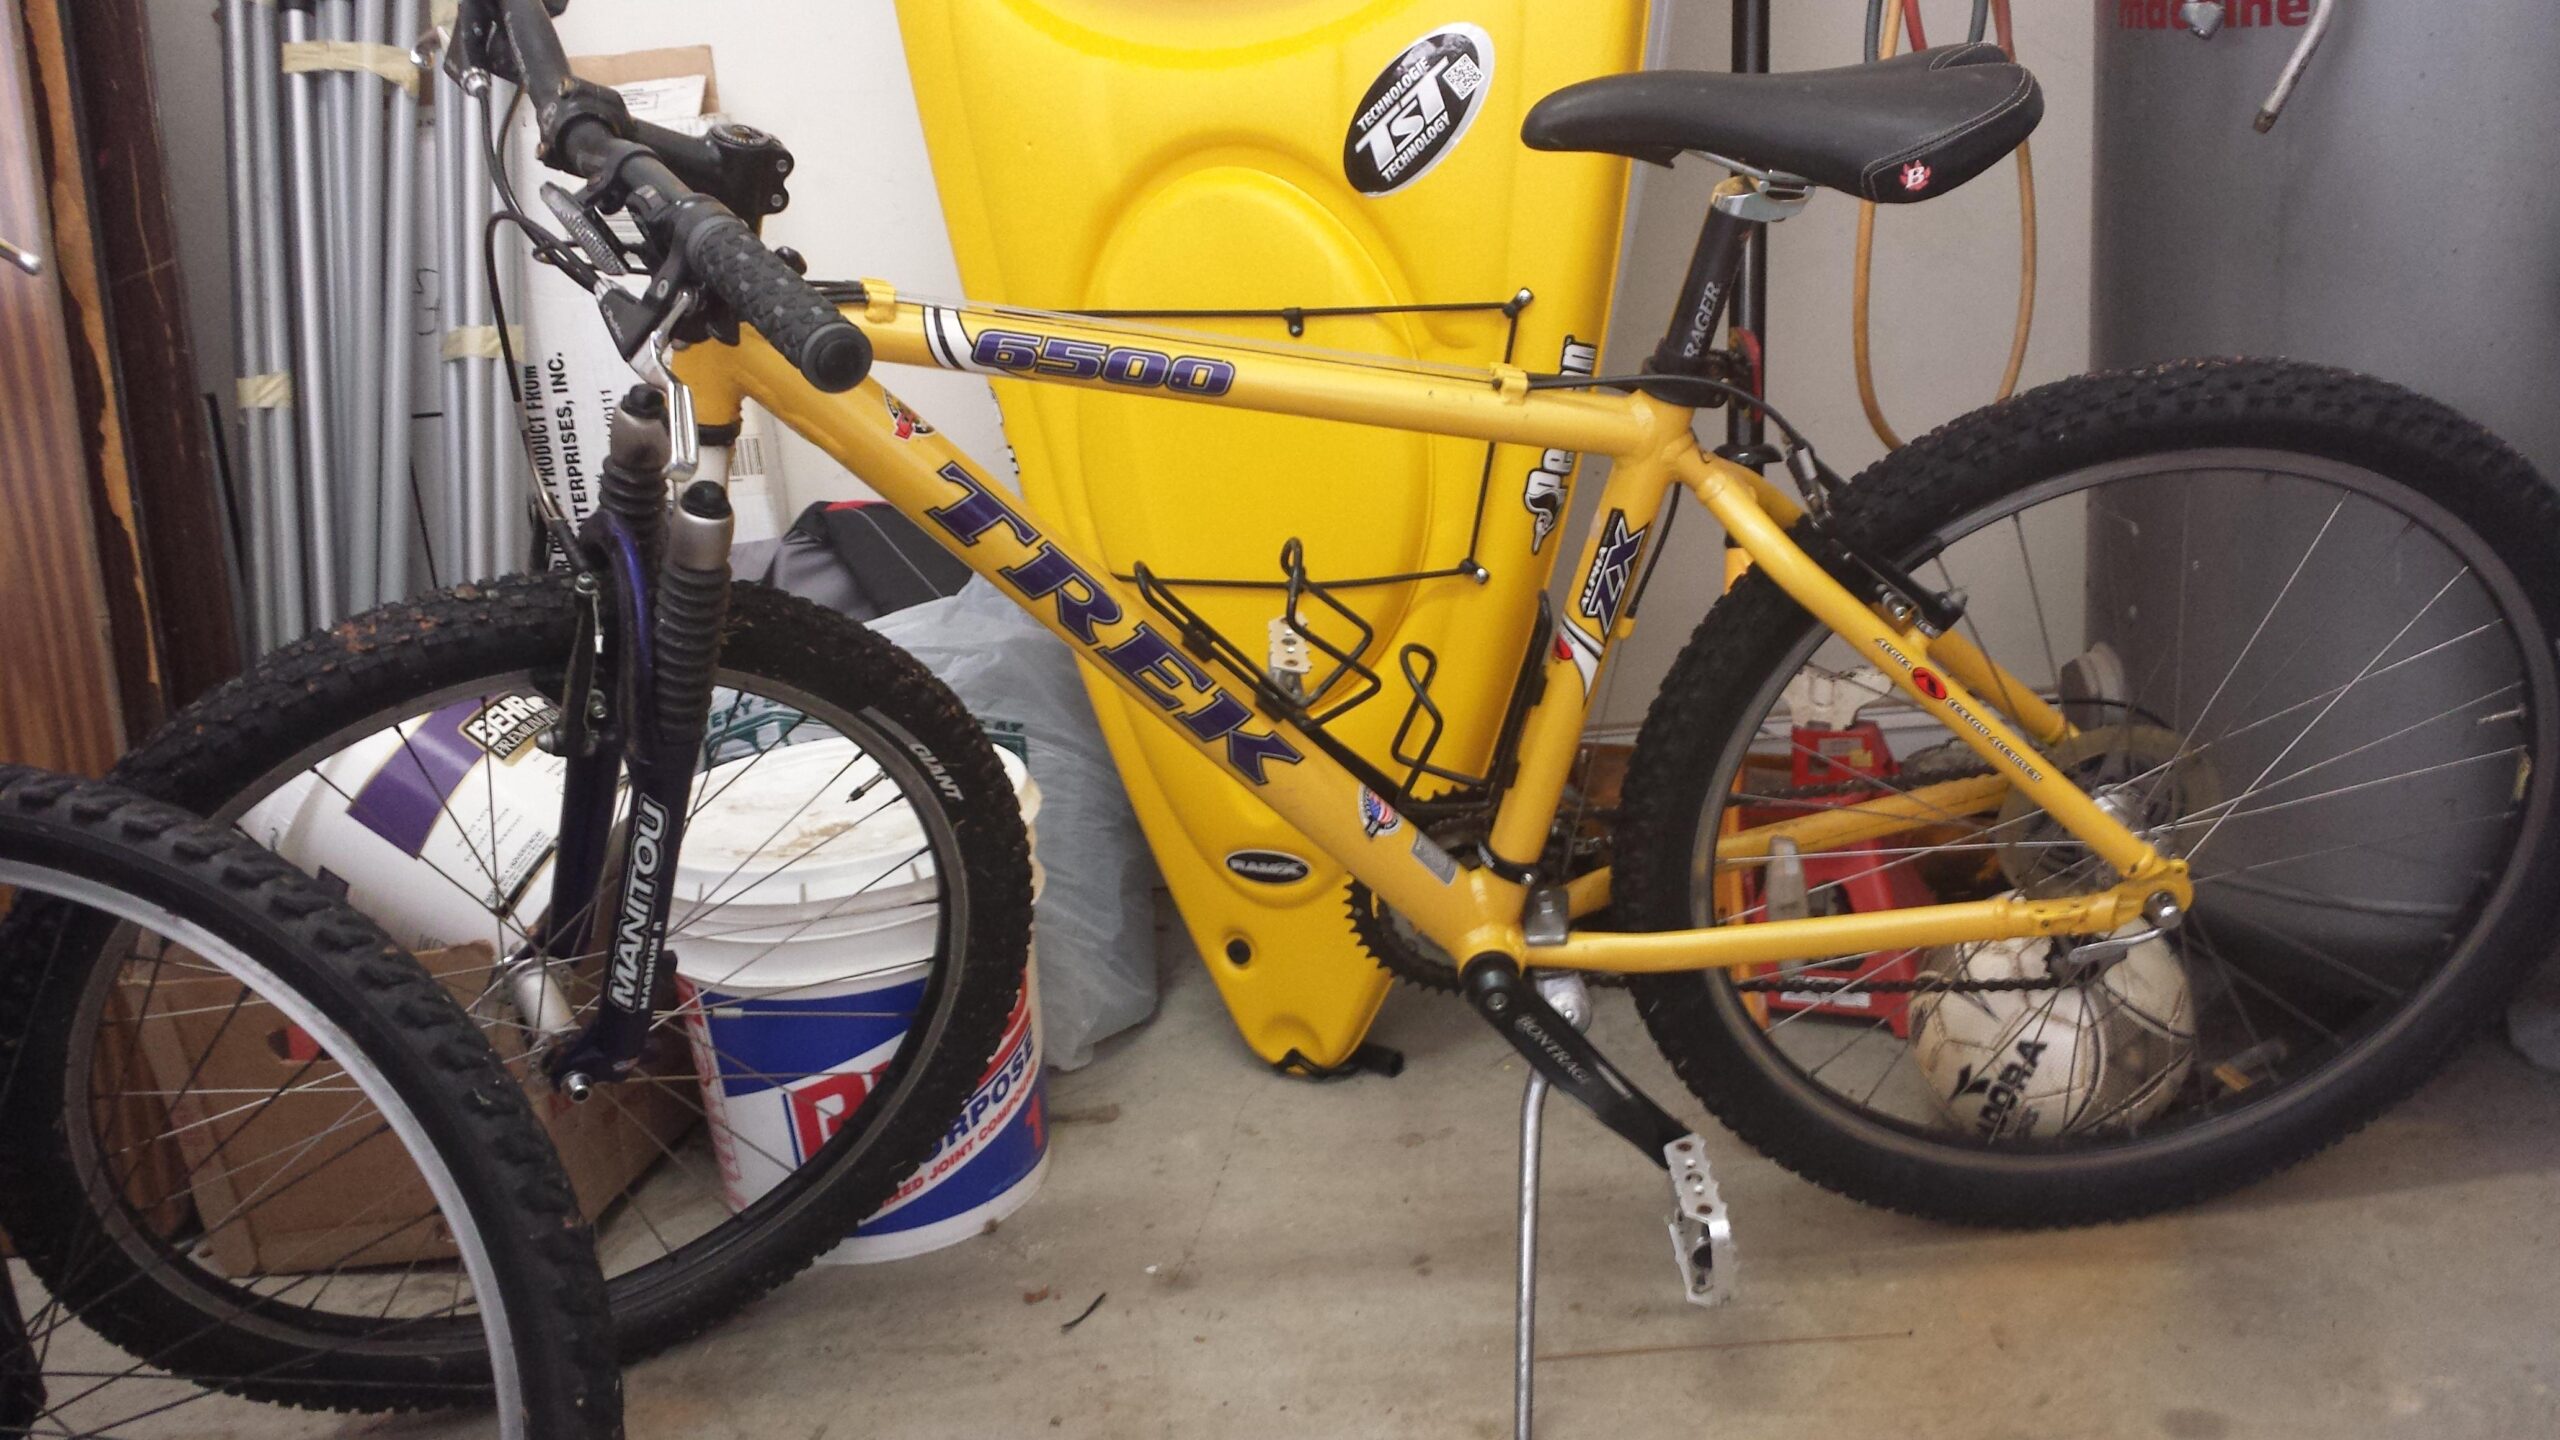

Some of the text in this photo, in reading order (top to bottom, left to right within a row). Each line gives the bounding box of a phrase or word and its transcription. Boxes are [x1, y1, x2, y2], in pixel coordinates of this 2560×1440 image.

[2117, 0, 2310, 30] macine
[1357, 56, 1431, 132] TECHNOLOGIE
[1381, 111, 1451, 182] TECHNOLOGY
[548, 352, 569, 393] INC.
[971, 329, 1236, 396] 6500
[924, 460, 1306, 786] TREK
[467, 695, 533, 747] BEHR
[493, 714, 548, 757] PREMIUM
[909, 743, 965, 801] GIANT
[609, 795, 668, 1011] MANITOU
[640, 937, 660, 1010] MAGNUM
[928, 1137, 975, 1181] JOINT
